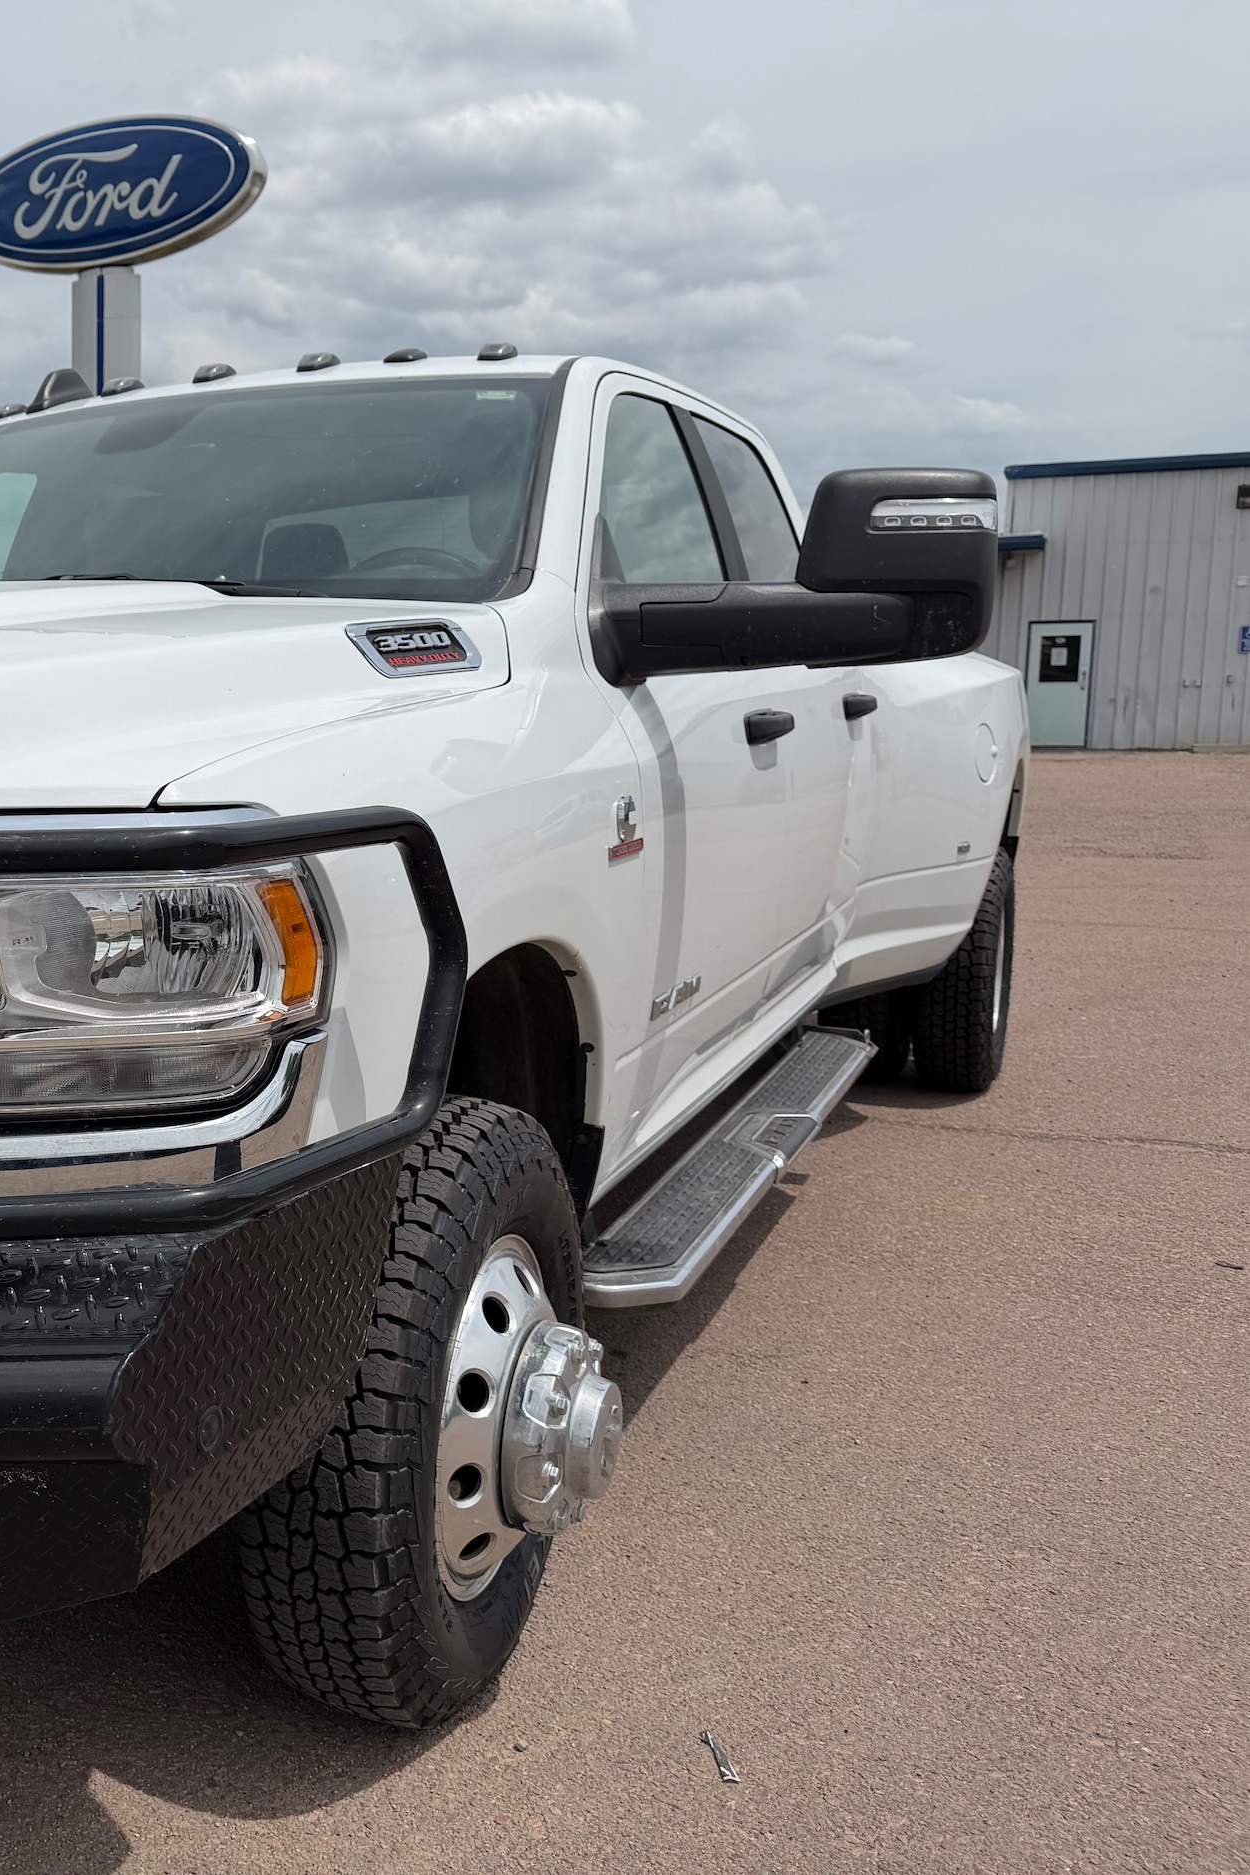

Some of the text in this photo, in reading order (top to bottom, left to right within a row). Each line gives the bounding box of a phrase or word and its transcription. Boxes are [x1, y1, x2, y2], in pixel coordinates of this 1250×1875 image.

[14, 143, 183, 240] Ford
[375, 632, 451, 652] 3500
[389, 652, 459, 666] HEAVY DUTY
